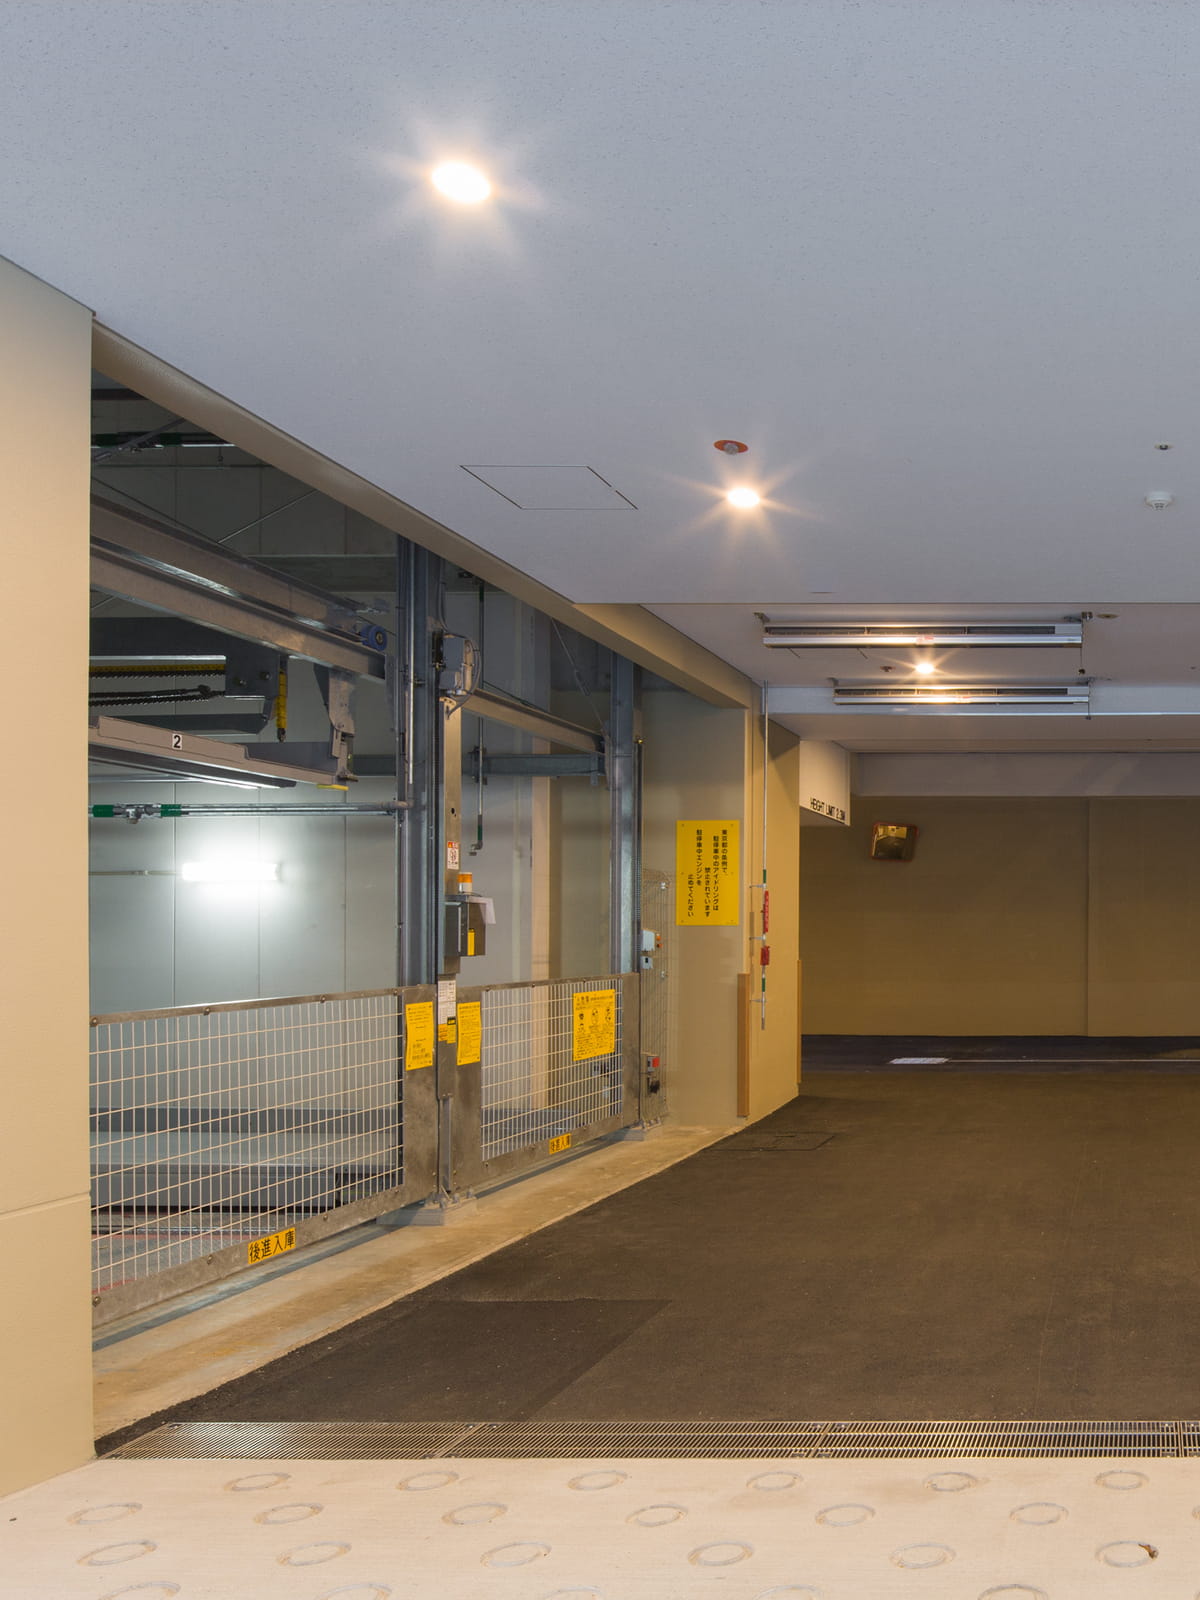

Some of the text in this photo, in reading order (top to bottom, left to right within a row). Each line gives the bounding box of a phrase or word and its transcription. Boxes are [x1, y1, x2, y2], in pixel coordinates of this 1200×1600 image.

[173, 734, 181, 749] 2
[249, 1230, 295, 1263] 後進入庫
